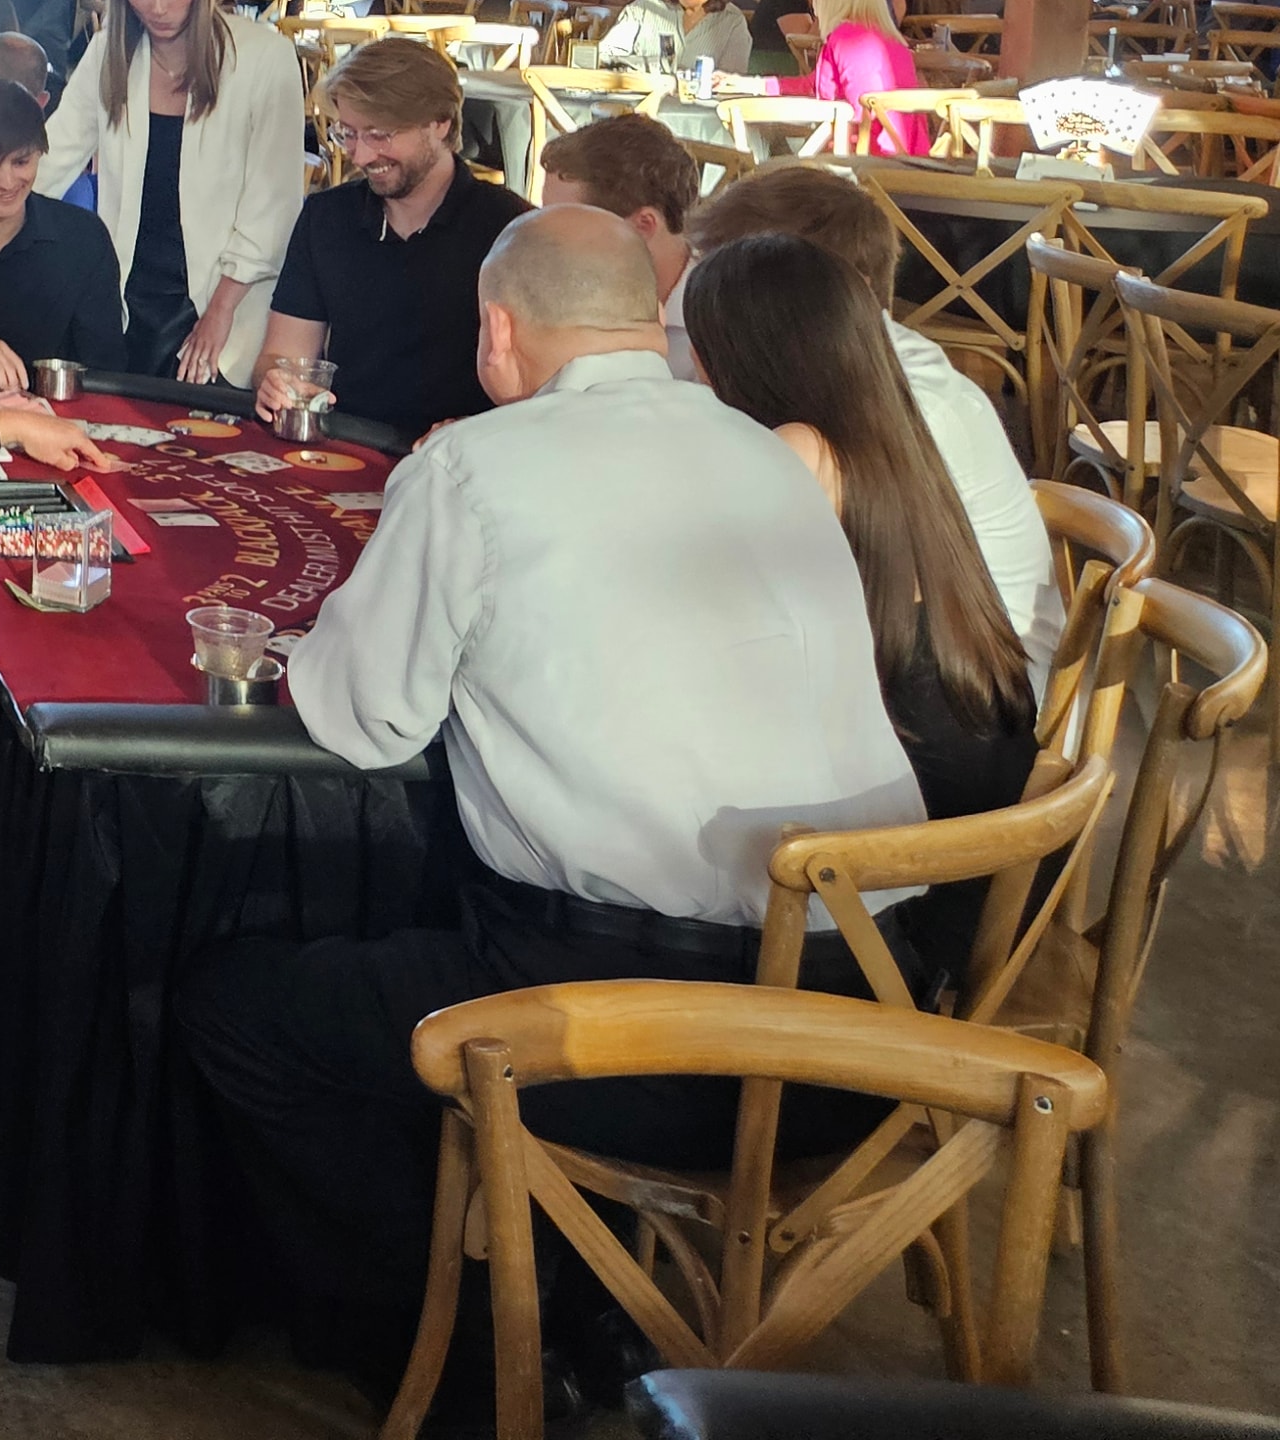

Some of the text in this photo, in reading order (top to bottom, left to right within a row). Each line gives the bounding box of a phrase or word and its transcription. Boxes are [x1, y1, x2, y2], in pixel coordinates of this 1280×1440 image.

[185, 473, 275, 503] SOFT
[180, 490, 281, 568] BLACKJACK
[257, 503, 313, 524] HIT
[289, 524, 340, 564] MUST
[260, 561, 339, 611] DEALER
